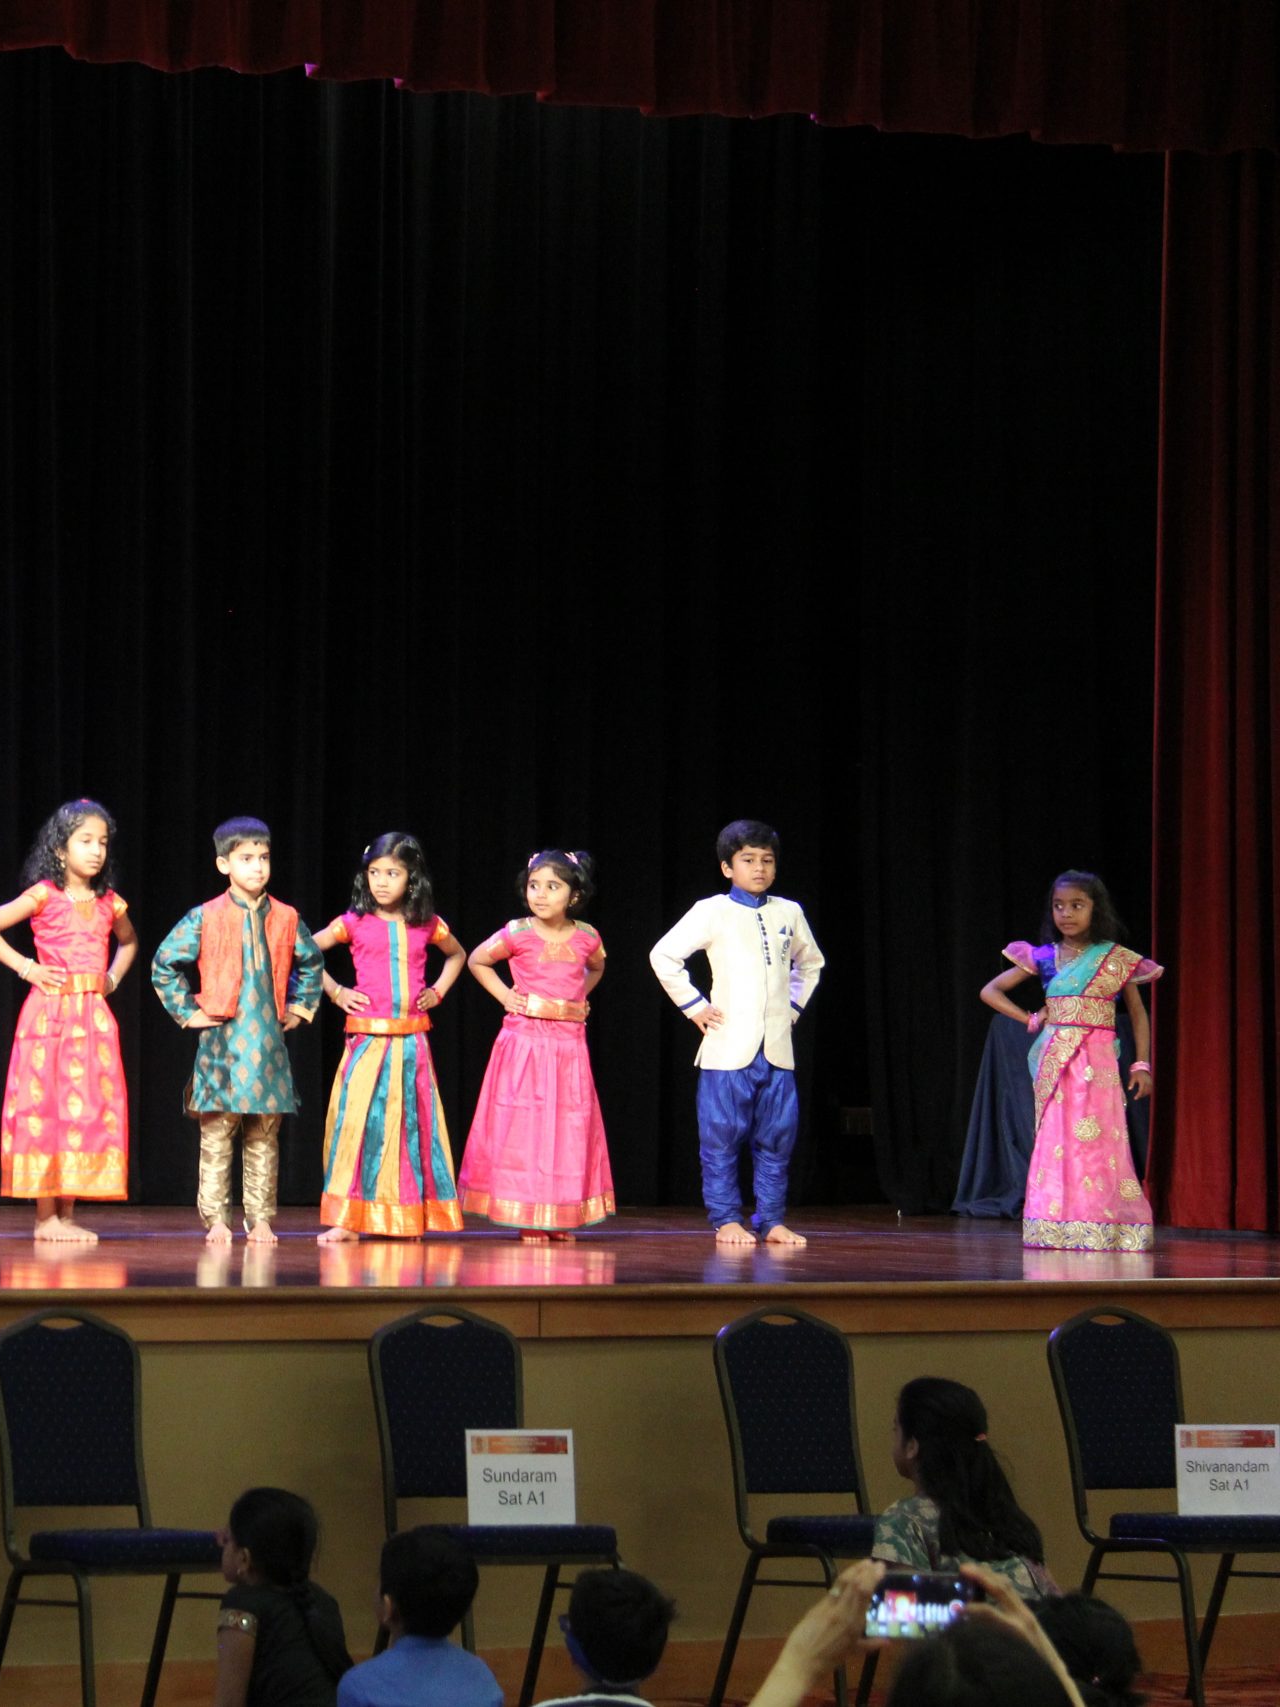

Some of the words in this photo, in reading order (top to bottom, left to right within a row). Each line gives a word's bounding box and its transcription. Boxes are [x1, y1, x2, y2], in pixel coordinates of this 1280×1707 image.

[1185, 1460, 1270, 1473] Shivanandam
[482, 1467, 558, 1484] Sundaram
[1209, 1478, 1230, 1491] Sat
[1233, 1479, 1250, 1491] A1
[498, 1490, 523, 1505] Sat
[526, 1490, 545, 1505] A1
